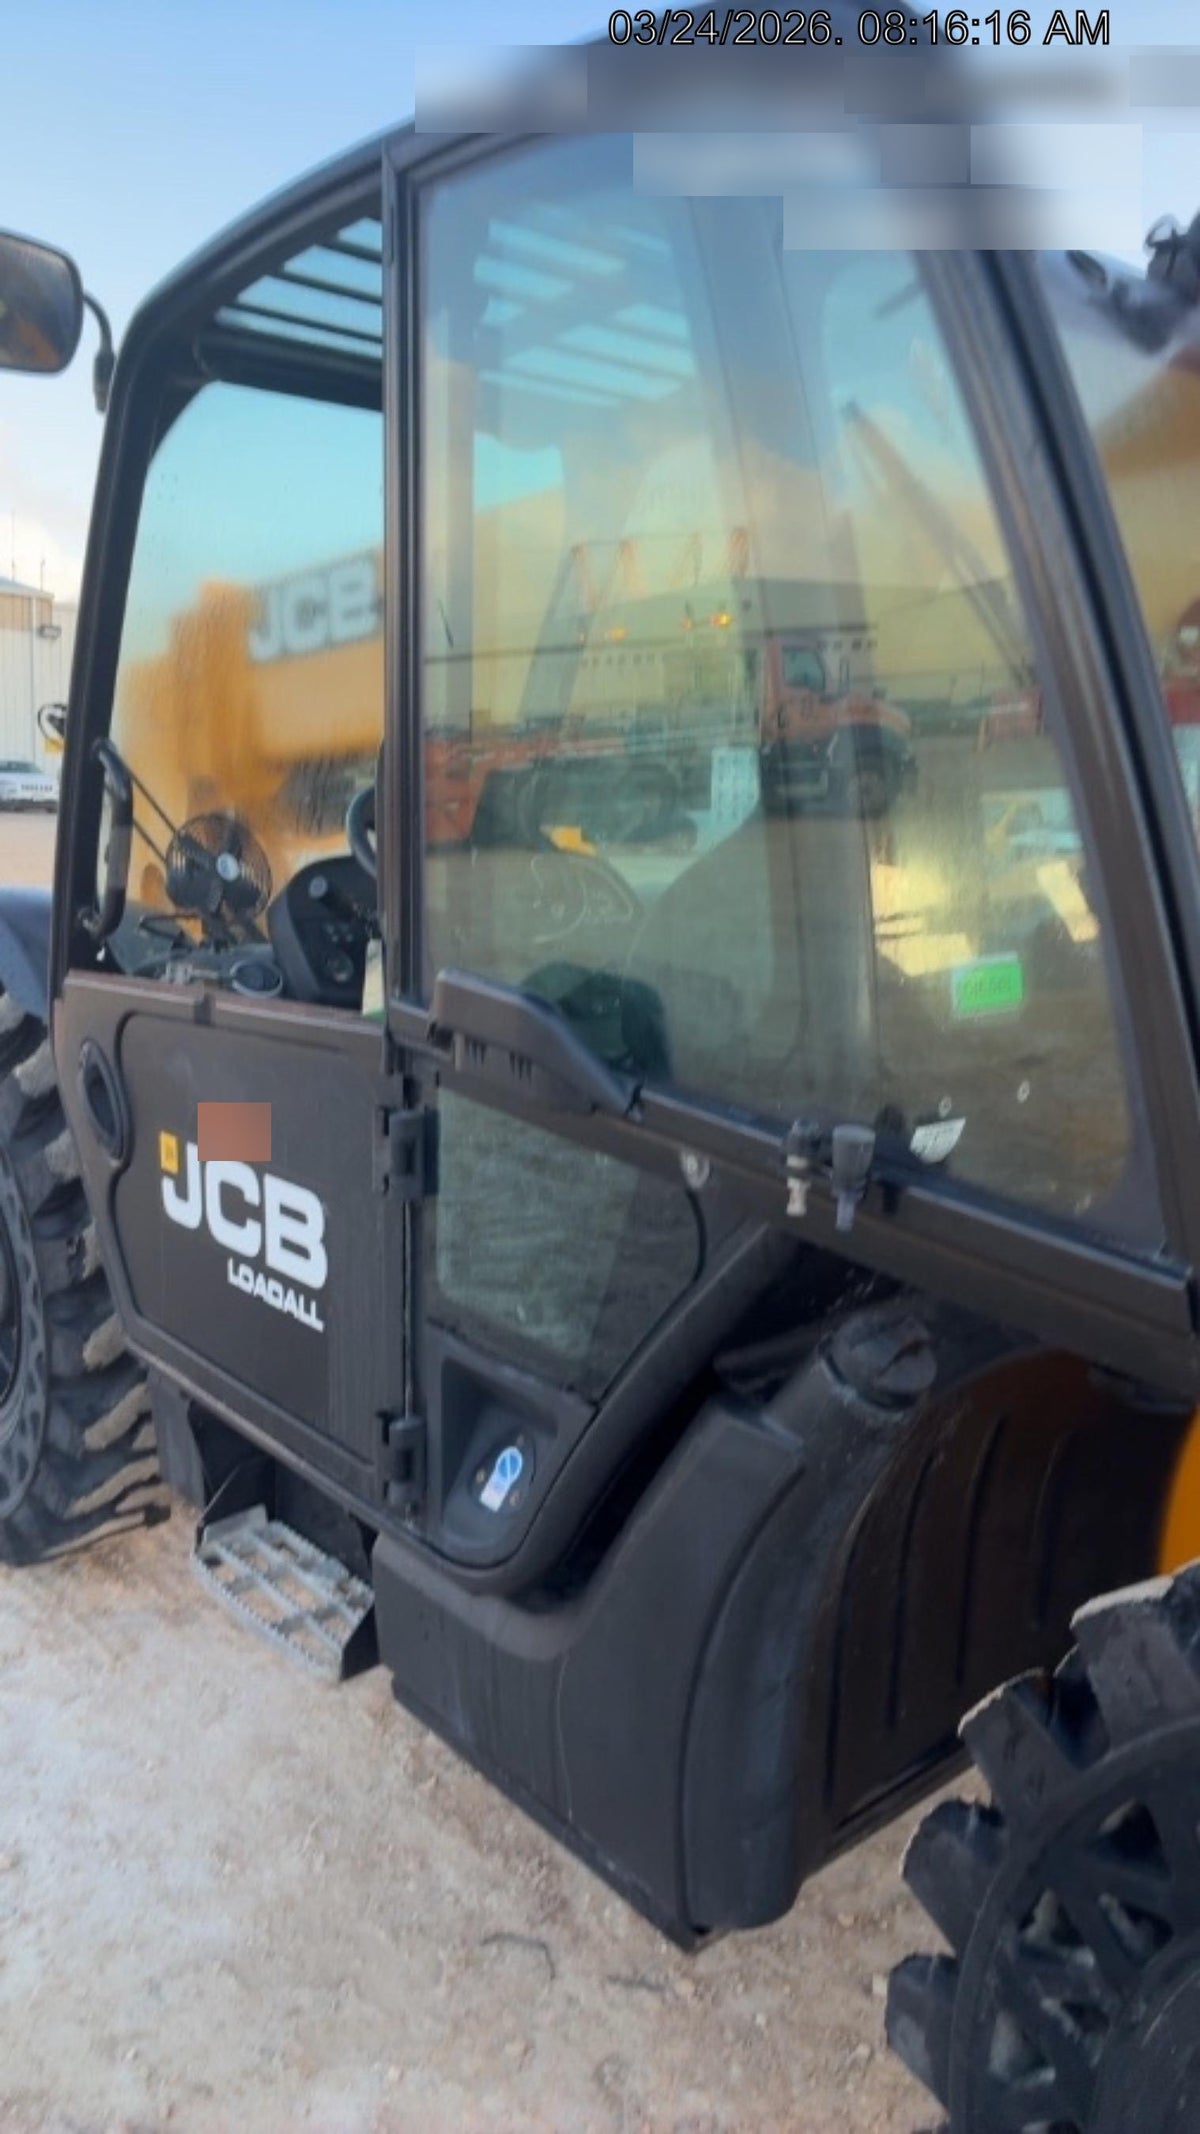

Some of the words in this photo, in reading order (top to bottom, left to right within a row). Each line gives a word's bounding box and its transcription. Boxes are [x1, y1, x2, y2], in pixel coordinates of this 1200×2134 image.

[248, 558, 378, 662] JCB
[161, 1141, 328, 1290] JCB
[227, 1257, 325, 1333] LOADALL
